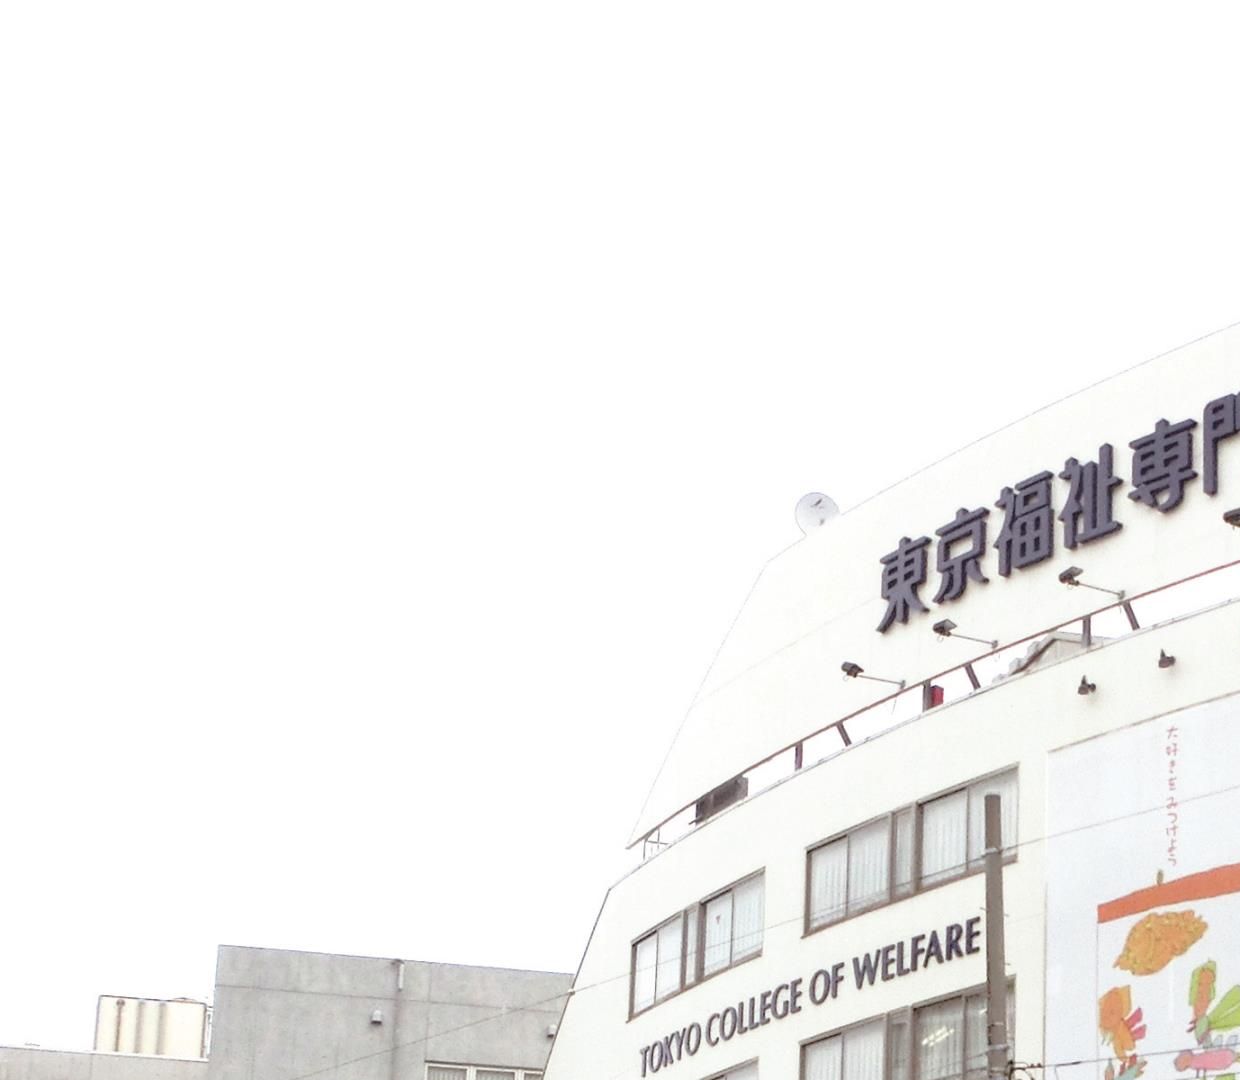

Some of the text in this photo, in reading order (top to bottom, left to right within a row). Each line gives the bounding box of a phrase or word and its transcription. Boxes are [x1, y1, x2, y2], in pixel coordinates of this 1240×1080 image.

[640, 916, 981, 1078] TOKYO COLLEGE OF WELFARE
